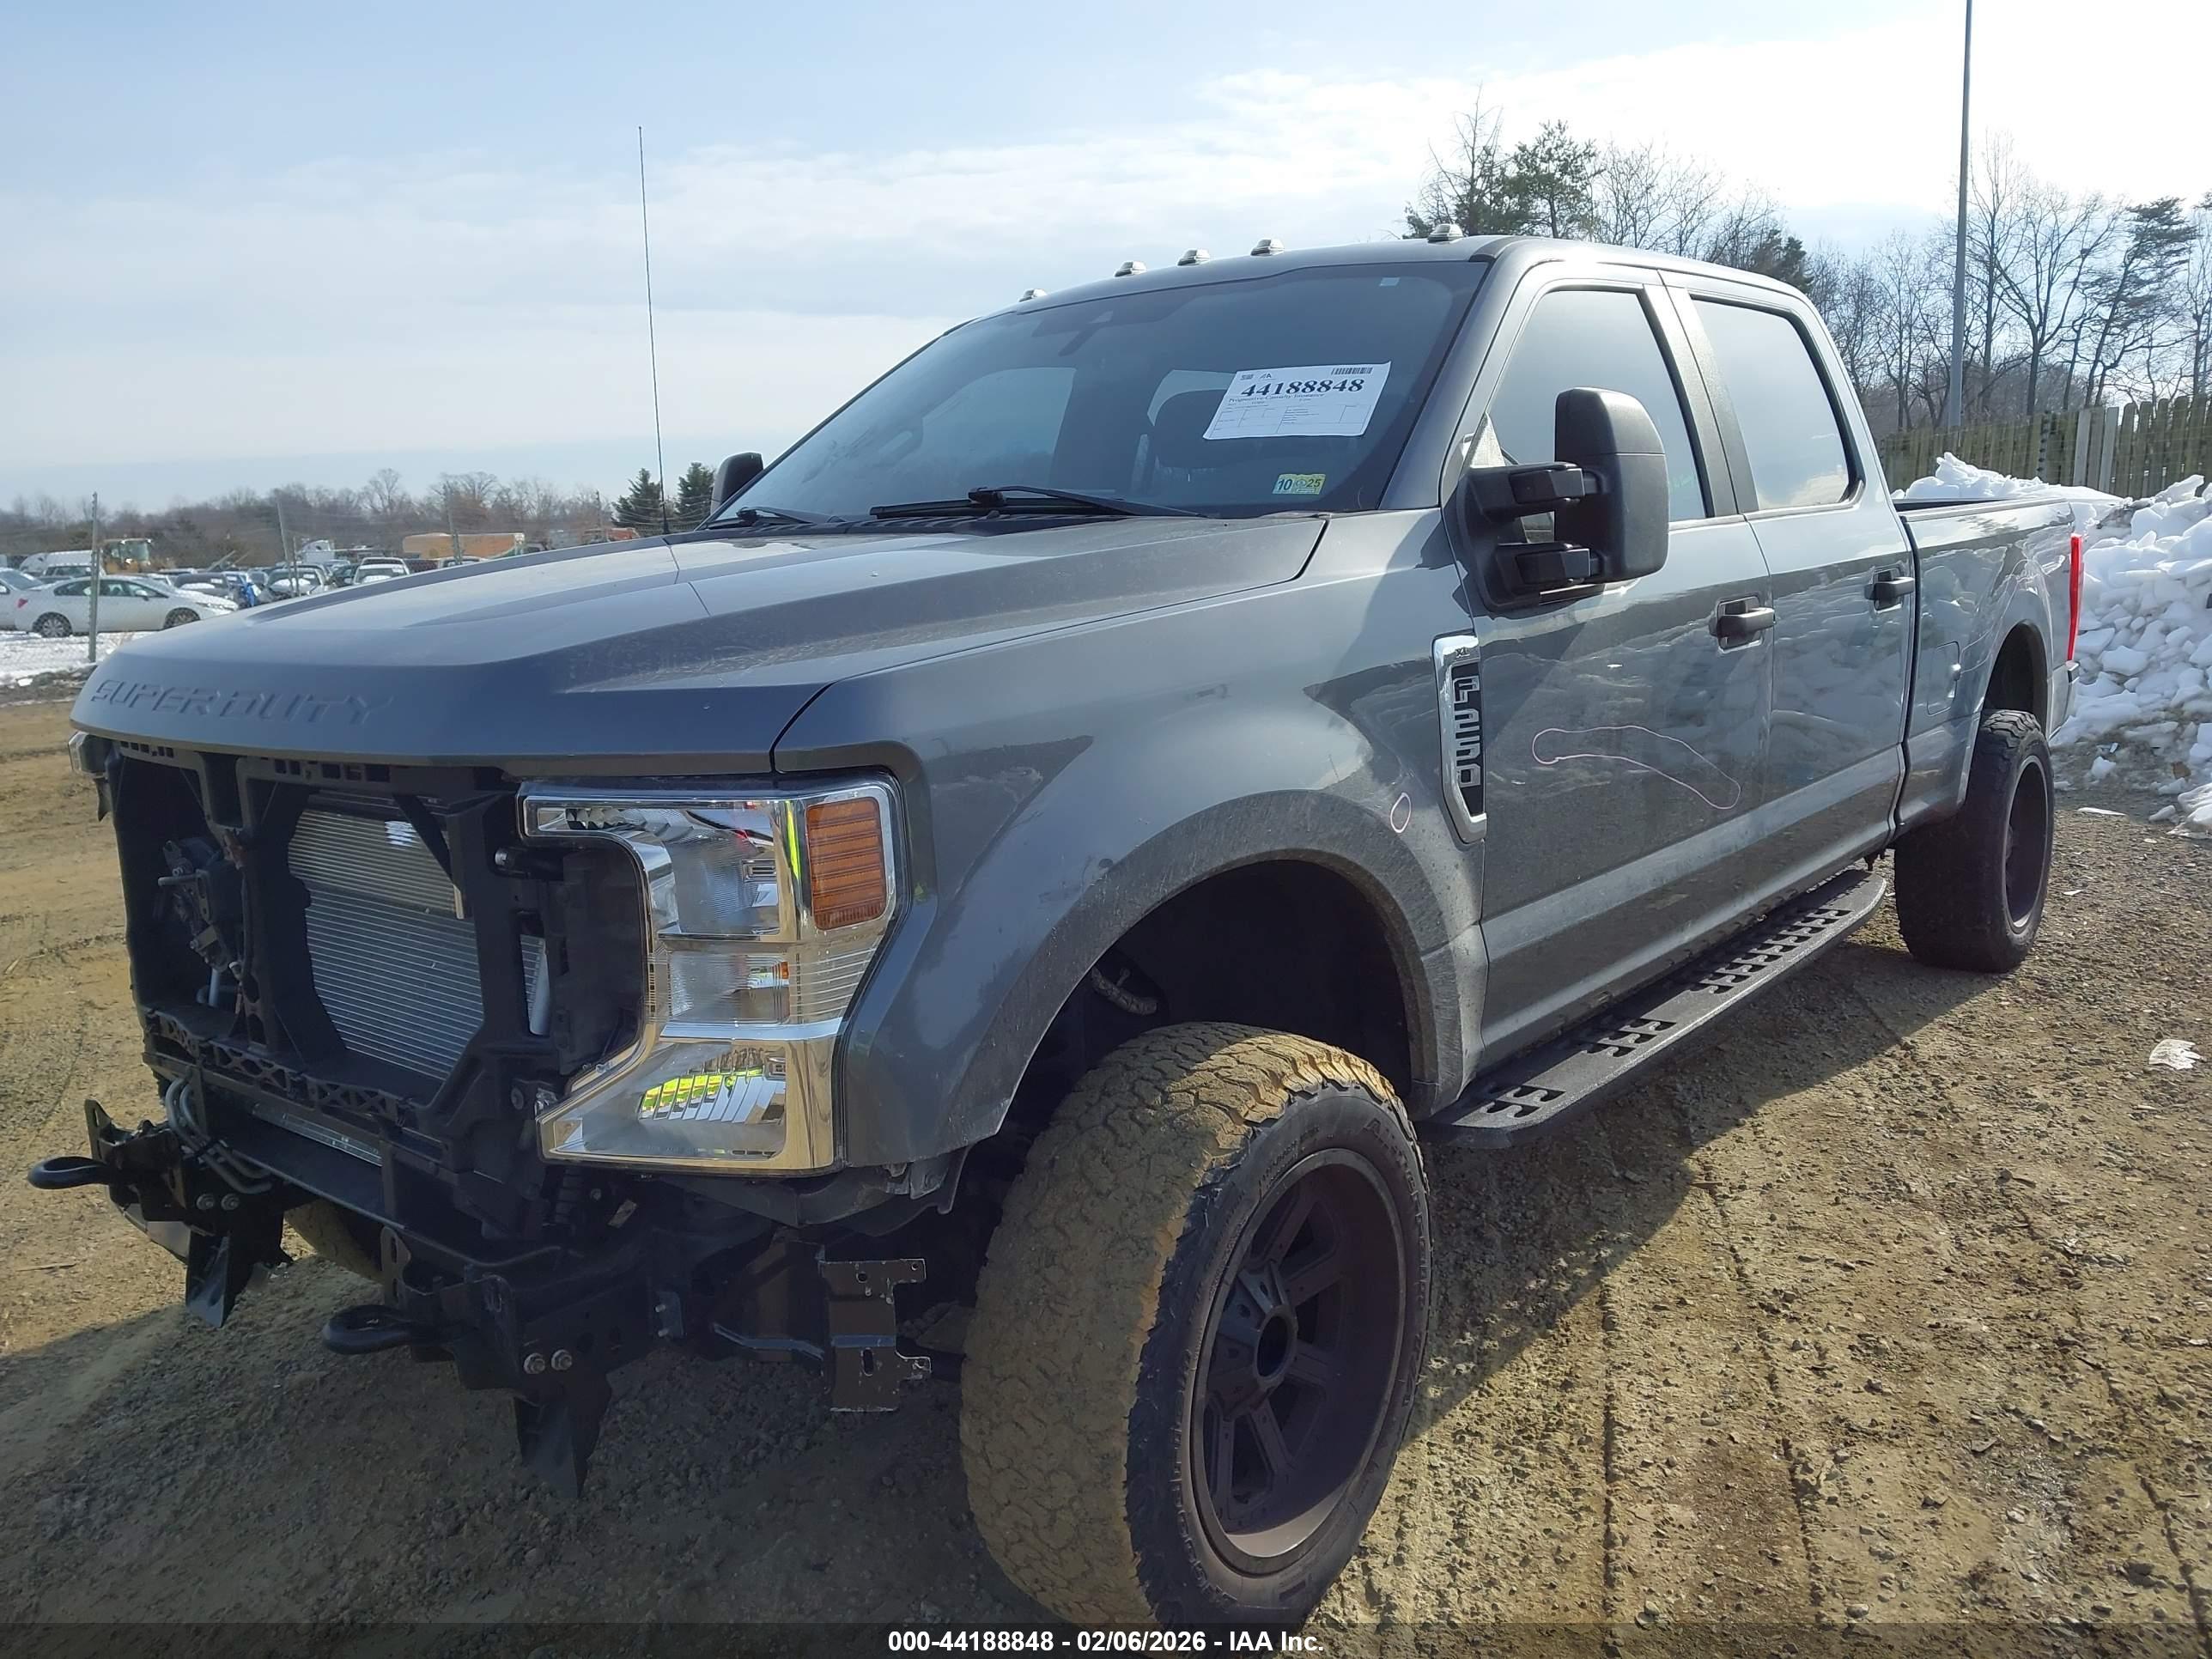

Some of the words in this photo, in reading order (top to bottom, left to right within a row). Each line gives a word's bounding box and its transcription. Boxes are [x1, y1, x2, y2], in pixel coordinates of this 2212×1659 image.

[1242, 379, 1364, 397] 44188848
[1278, 478, 1293, 491] 10
[1306, 478, 1322, 488] 25
[91, 678, 220, 716] SUPER
[219, 691, 395, 726] DUTY
